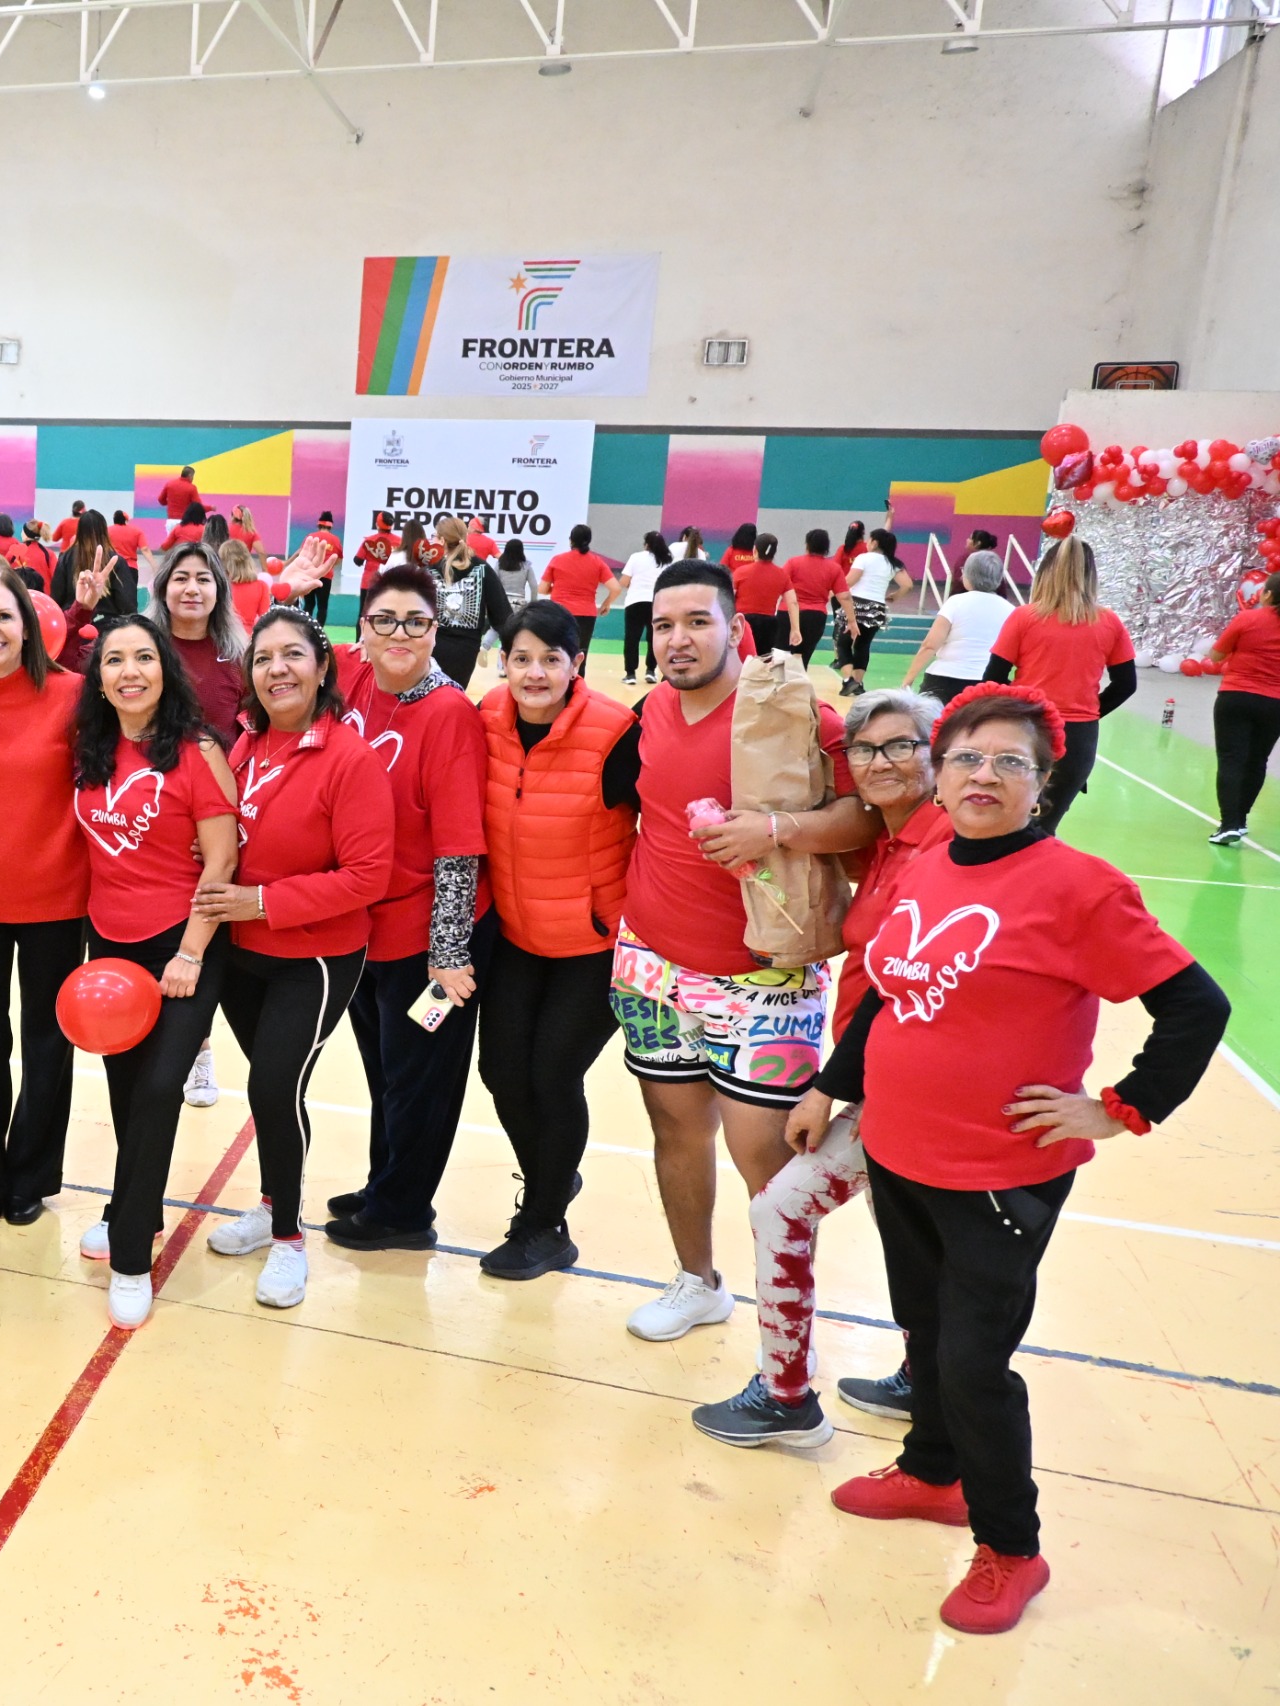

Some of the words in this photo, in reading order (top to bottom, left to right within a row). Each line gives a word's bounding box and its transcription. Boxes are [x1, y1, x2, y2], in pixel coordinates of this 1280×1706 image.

[461, 338, 615, 358] FRONTERA
[498, 374, 535, 382] Gobierno
[536, 374, 573, 383] Municipal
[539, 382, 559, 390] 2027
[511, 457, 558, 465] FRONTERA
[386, 487, 540, 511] FOMENTO
[90, 808, 128, 827] ZUMBA
[113, 802, 160, 850] love
[882, 956, 931, 983] ZUMBA
[906, 951, 980, 1022] love
[745, 990, 759, 1003] A
[761, 991, 799, 1006] NICE
